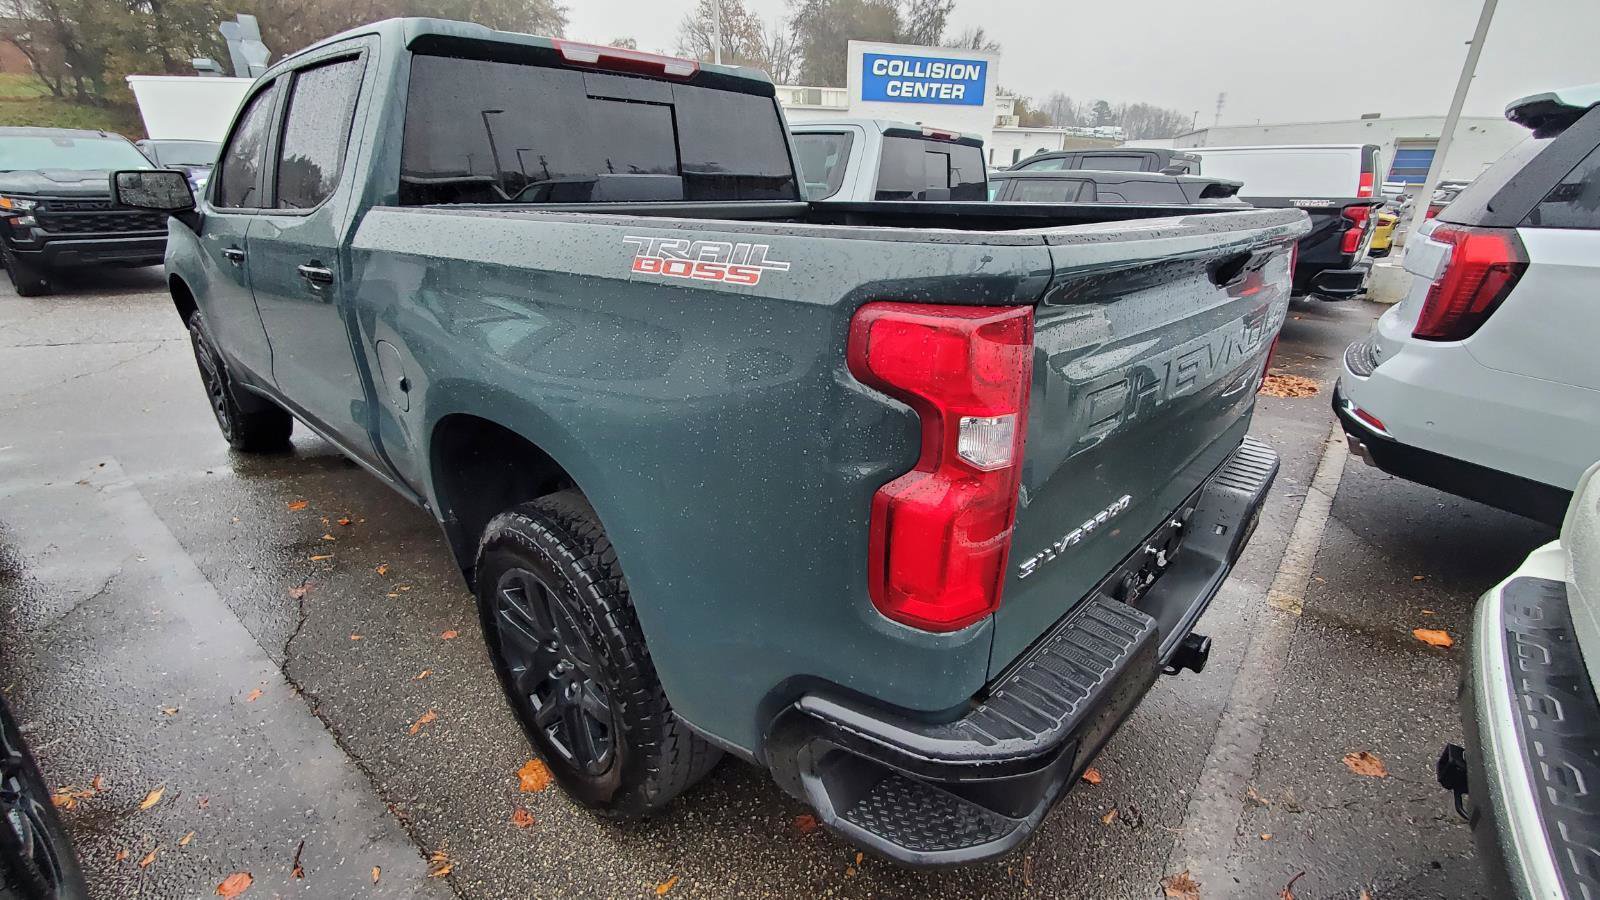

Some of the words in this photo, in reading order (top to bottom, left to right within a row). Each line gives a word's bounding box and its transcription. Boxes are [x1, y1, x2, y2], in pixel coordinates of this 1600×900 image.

[872, 58, 980, 81] COLLISION
[886, 80, 965, 100] CENTER
[622, 235, 790, 271] TRAIL
[631, 255, 763, 286] BOSS
[1018, 494, 1132, 579] SILVERADO
